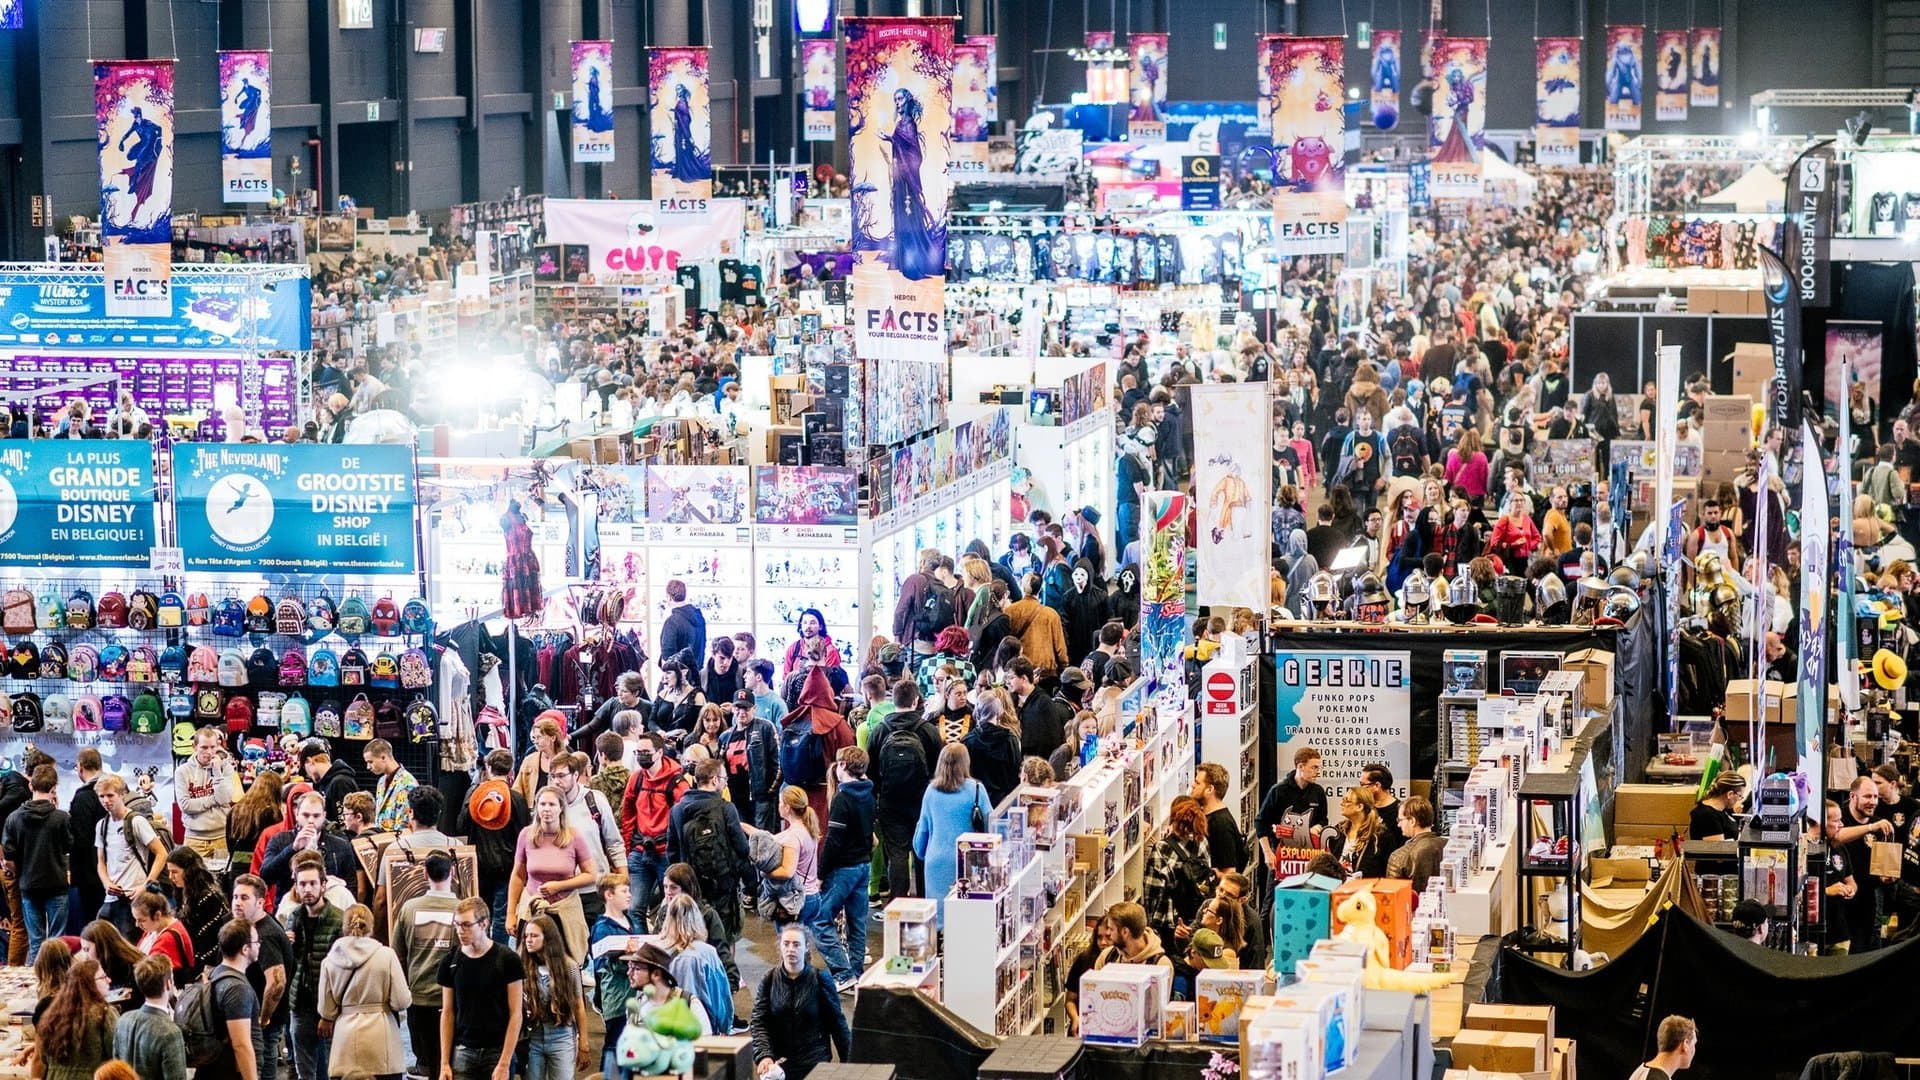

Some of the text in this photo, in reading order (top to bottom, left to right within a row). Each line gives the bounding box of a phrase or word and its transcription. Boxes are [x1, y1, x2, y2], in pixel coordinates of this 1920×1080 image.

[1133, 128, 1162, 136] FACTS
[1541, 144, 1574, 152] FACTS
[230, 178, 268, 189] FACTS
[1437, 172, 1478, 183] FACTS
[660, 197, 706, 210] FACTS
[1283, 220, 1339, 236] FACTS
[1801, 196, 1817, 300] ZILVERSPOOR
[606, 245, 682, 272] CUTE
[39, 281, 89, 298] Mike's
[114, 276, 167, 295] FACTS
[867, 306, 938, 332] FACTS
[68, 452, 120, 464] LA PLUS
[197, 448, 280, 475] THE NEVERLAND
[342, 457, 360, 469] DE
[50, 468, 141, 486] GRANDE
[297, 473, 406, 492] GROOTSTE
[61, 489, 130, 502] BOUTIQUE
[312, 494, 392, 513] DISNEY
[58, 504, 136, 523] DISNEY
[333, 516, 371, 528] SHOP
[52, 529, 69, 540] EN
[72, 529, 136, 542] BELGIQUE
[318, 534, 331, 546] IN
[335, 532, 381, 546] BELGIË
[42, 553, 74, 562] (Belgique)
[1284, 658, 1402, 688] GEEKIE
[1366, 727, 1401, 735] GAMES
[1512, 755, 1520, 792] PENNYWISE
[1281, 860, 1308, 874] KITT
